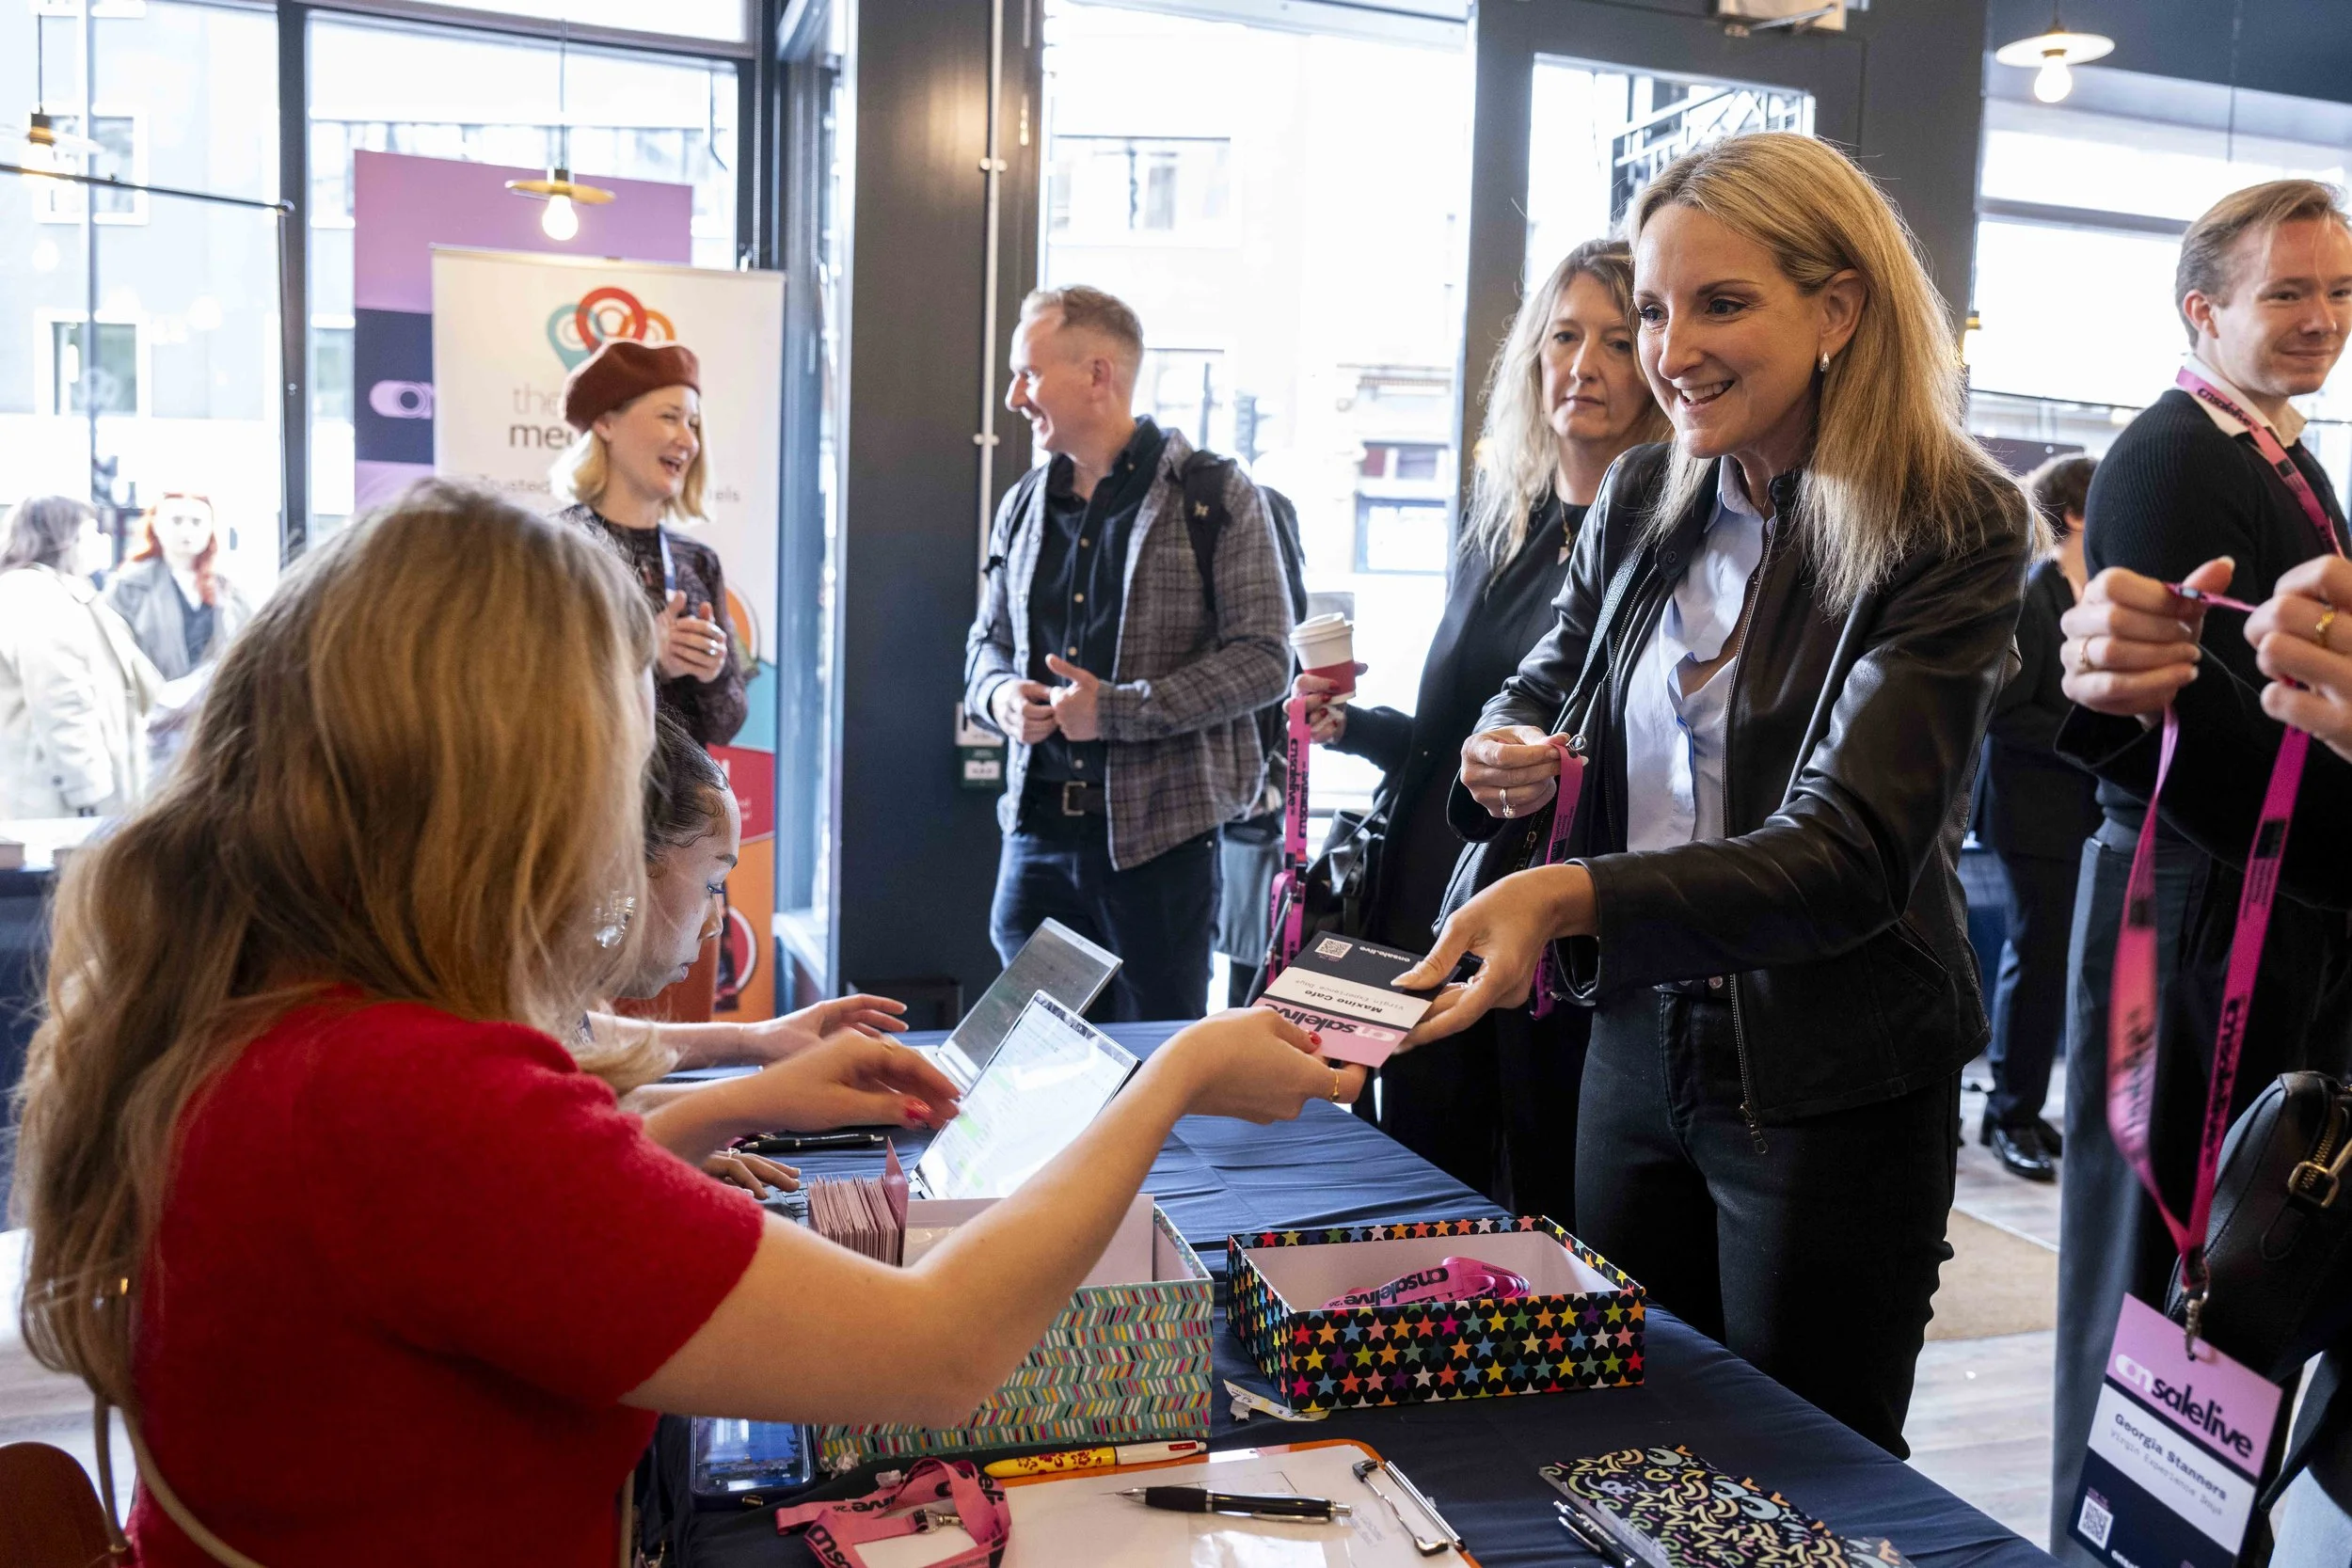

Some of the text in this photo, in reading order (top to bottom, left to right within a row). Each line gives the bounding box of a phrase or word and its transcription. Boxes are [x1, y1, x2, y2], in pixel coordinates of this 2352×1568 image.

[1359, 945, 1411, 963] onsale.live
[1305, 990, 1383, 1013] Maxine Cafe
[1344, 1267, 1449, 1307] onsalelive
[2115, 1354, 2254, 1459] onsalelive
[2115, 1413, 2227, 1501] Georgia Stanners
